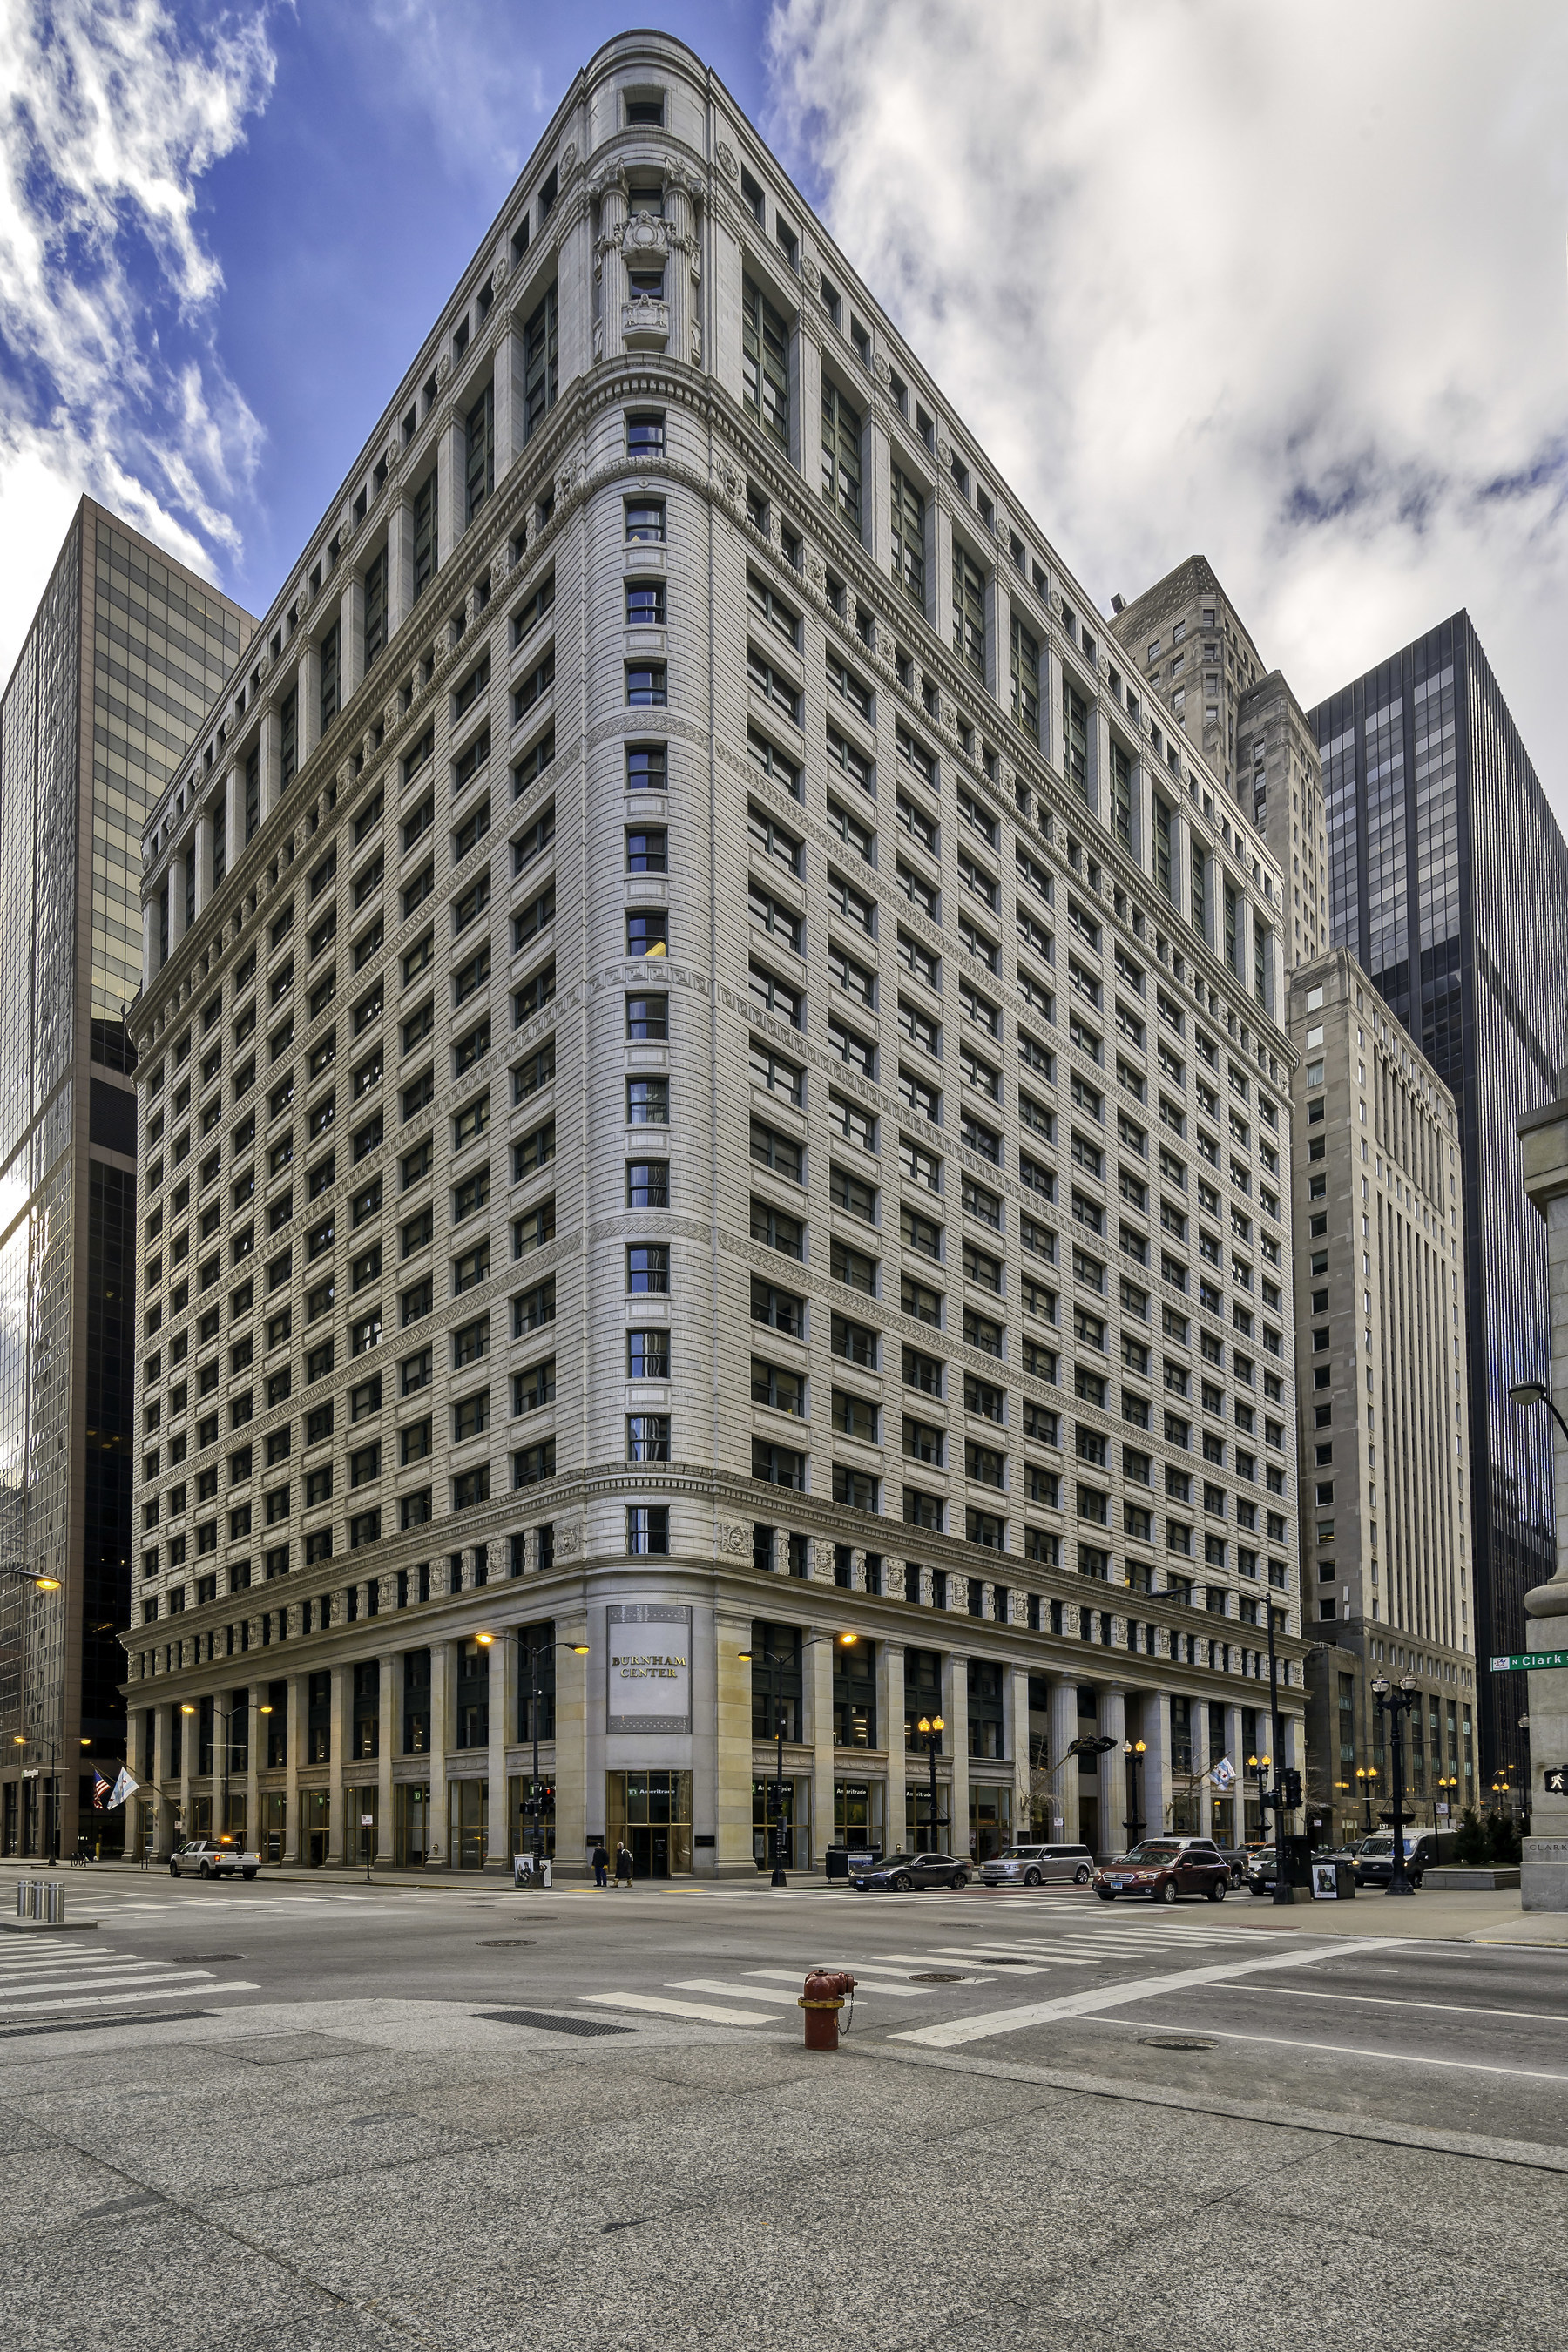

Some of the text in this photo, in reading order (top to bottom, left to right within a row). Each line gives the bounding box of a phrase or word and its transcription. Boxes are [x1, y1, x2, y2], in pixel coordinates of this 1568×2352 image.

[612, 1656, 686, 1666] BURNHAM
[1522, 1654, 1562, 1666] Clark
[620, 1668, 678, 1678] CENTER
